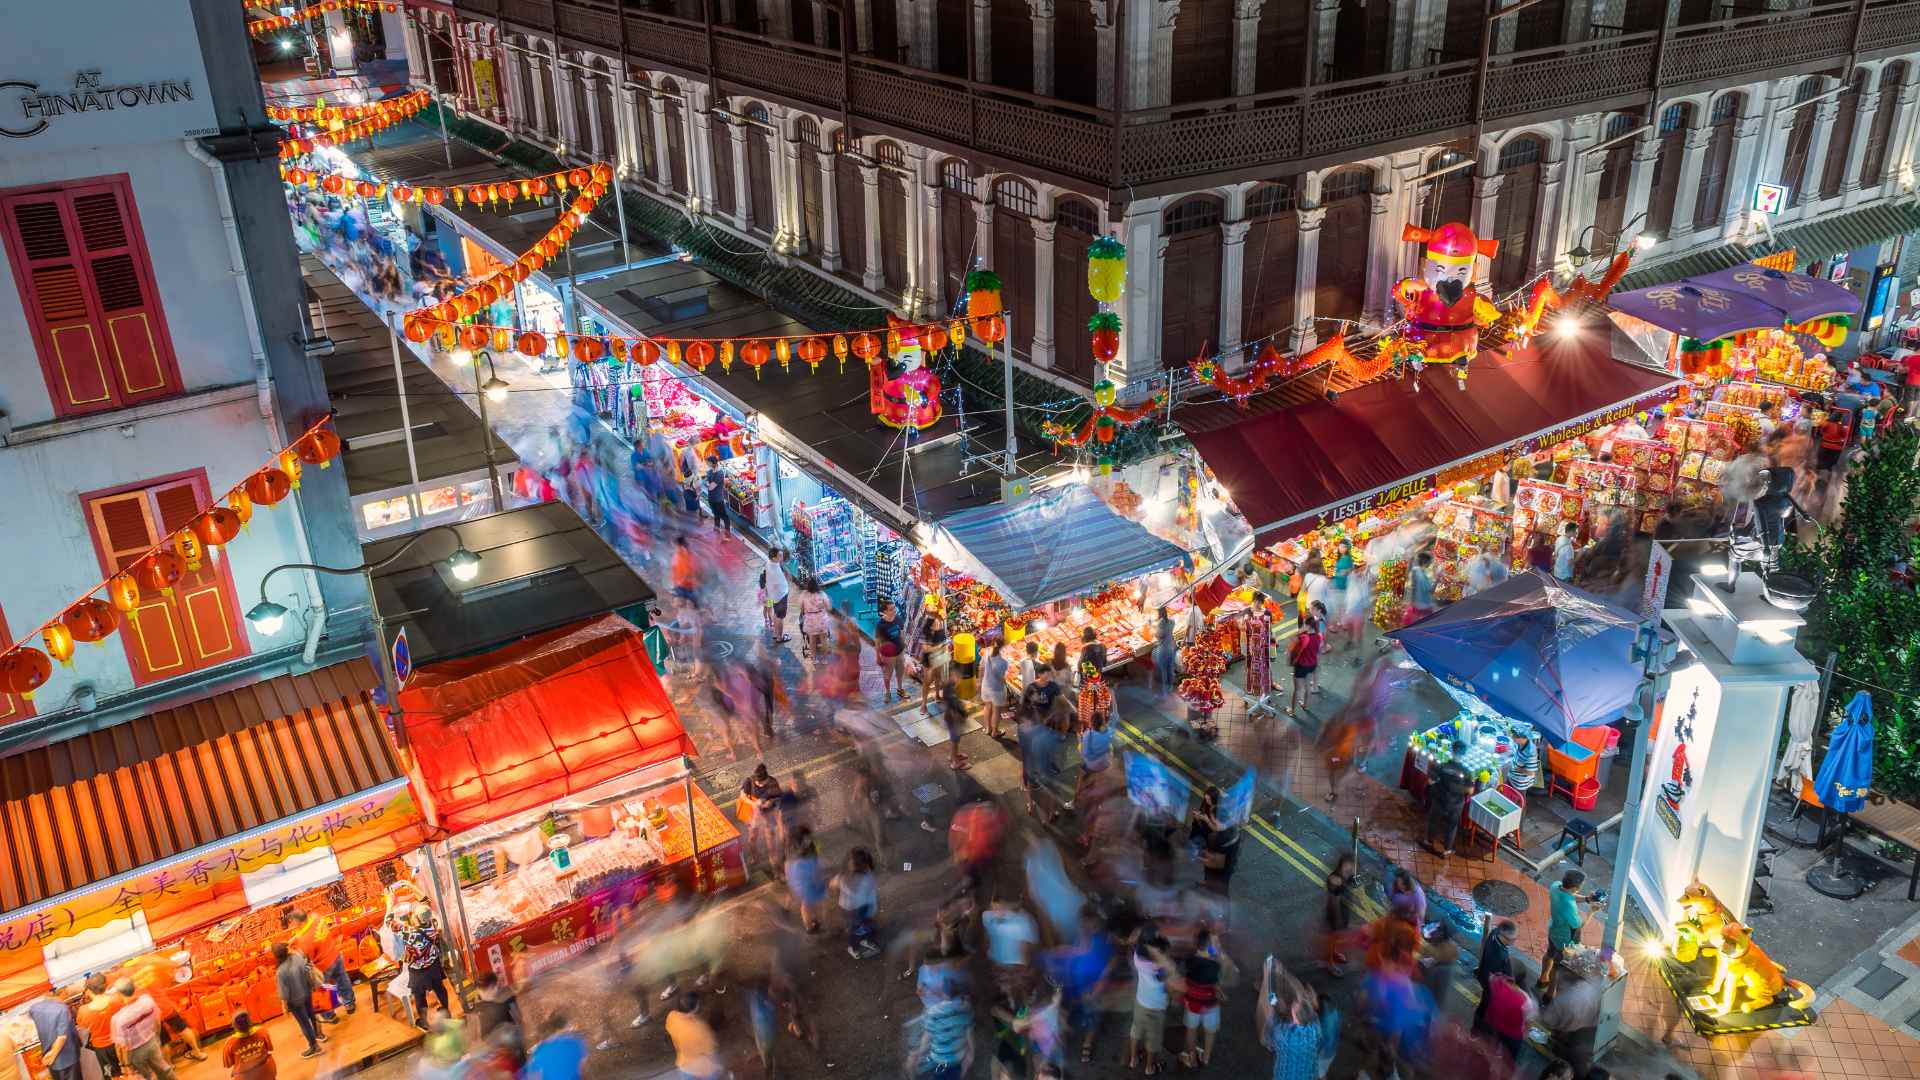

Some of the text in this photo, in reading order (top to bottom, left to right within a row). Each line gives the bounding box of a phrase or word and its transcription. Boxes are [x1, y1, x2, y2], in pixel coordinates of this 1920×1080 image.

[75, 71, 102, 89] AT
[1538, 421, 1591, 450] Wholesale
[1605, 403, 1636, 425] Retail
[1333, 496, 1373, 523] LESLIE
[1375, 477, 1427, 506] JAVELLE
[111, 801, 385, 915] 全美香水与化妆品
